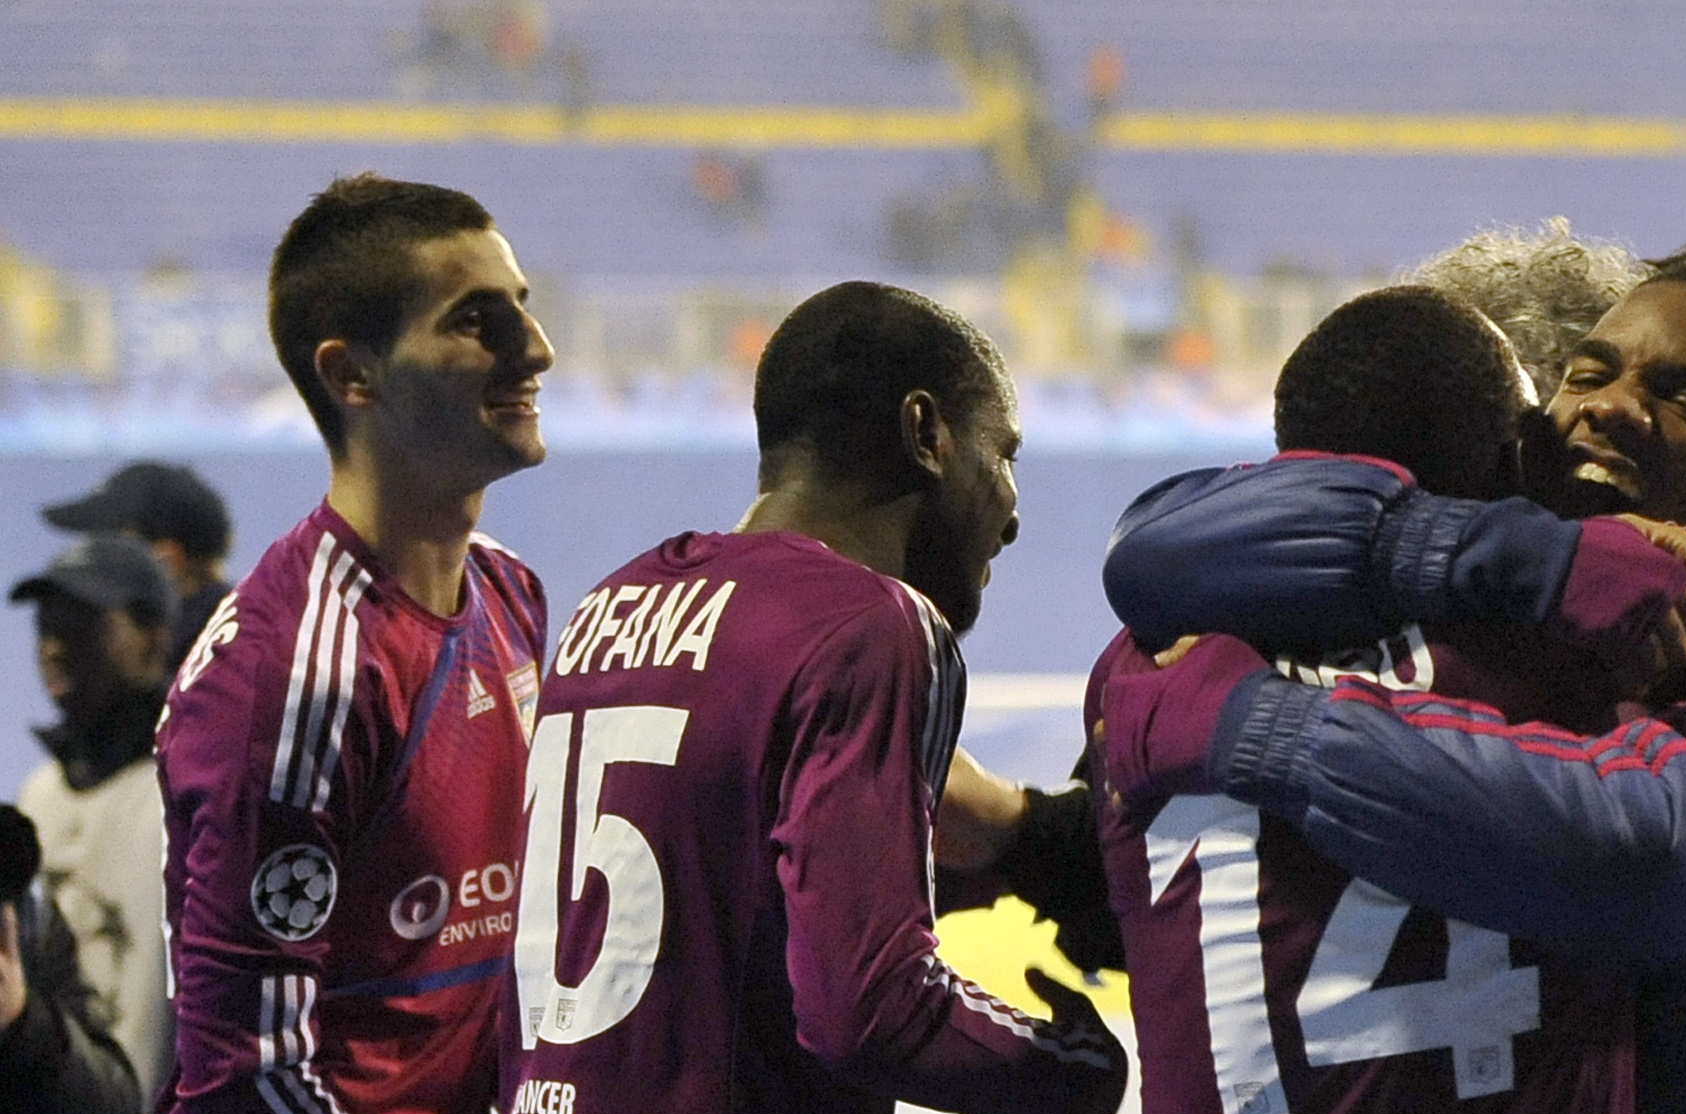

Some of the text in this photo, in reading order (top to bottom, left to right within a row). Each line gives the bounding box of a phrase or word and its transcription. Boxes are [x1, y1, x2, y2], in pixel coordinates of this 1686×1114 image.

[557, 578, 737, 676] OFANA
[460, 861, 519, 907] EO
[514, 705, 690, 1050] 15
